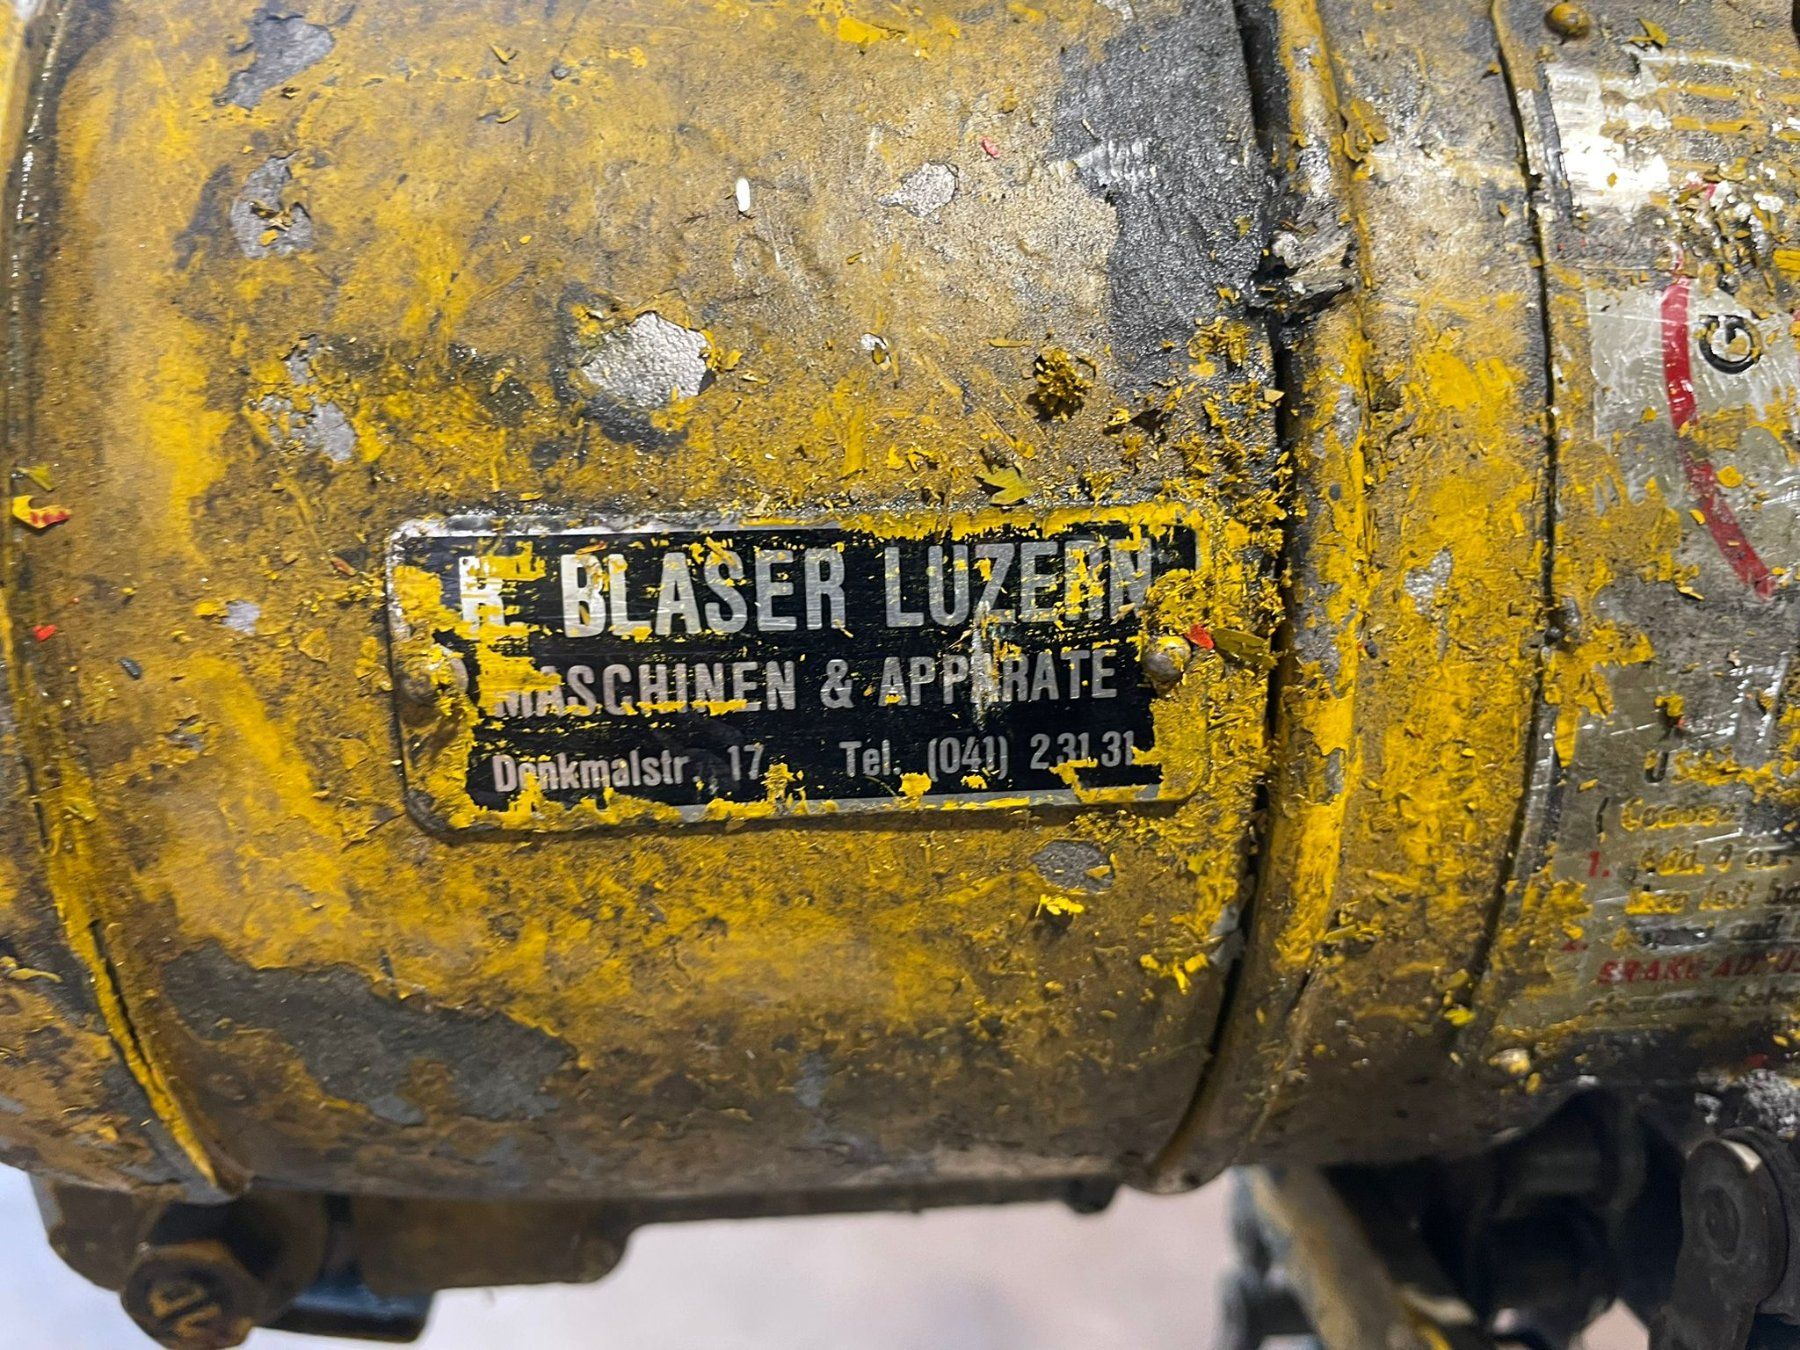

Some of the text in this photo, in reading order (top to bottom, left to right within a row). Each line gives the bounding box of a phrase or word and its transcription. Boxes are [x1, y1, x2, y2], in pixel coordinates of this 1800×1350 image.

[560, 547, 846, 638] BLASER
[884, 538, 1152, 628] LUZERN
[820, 658, 854, 709] &
[727, 744, 765, 782] 17
[839, 739, 900, 778] Tel.
[927, 735, 1009, 784] (041)
